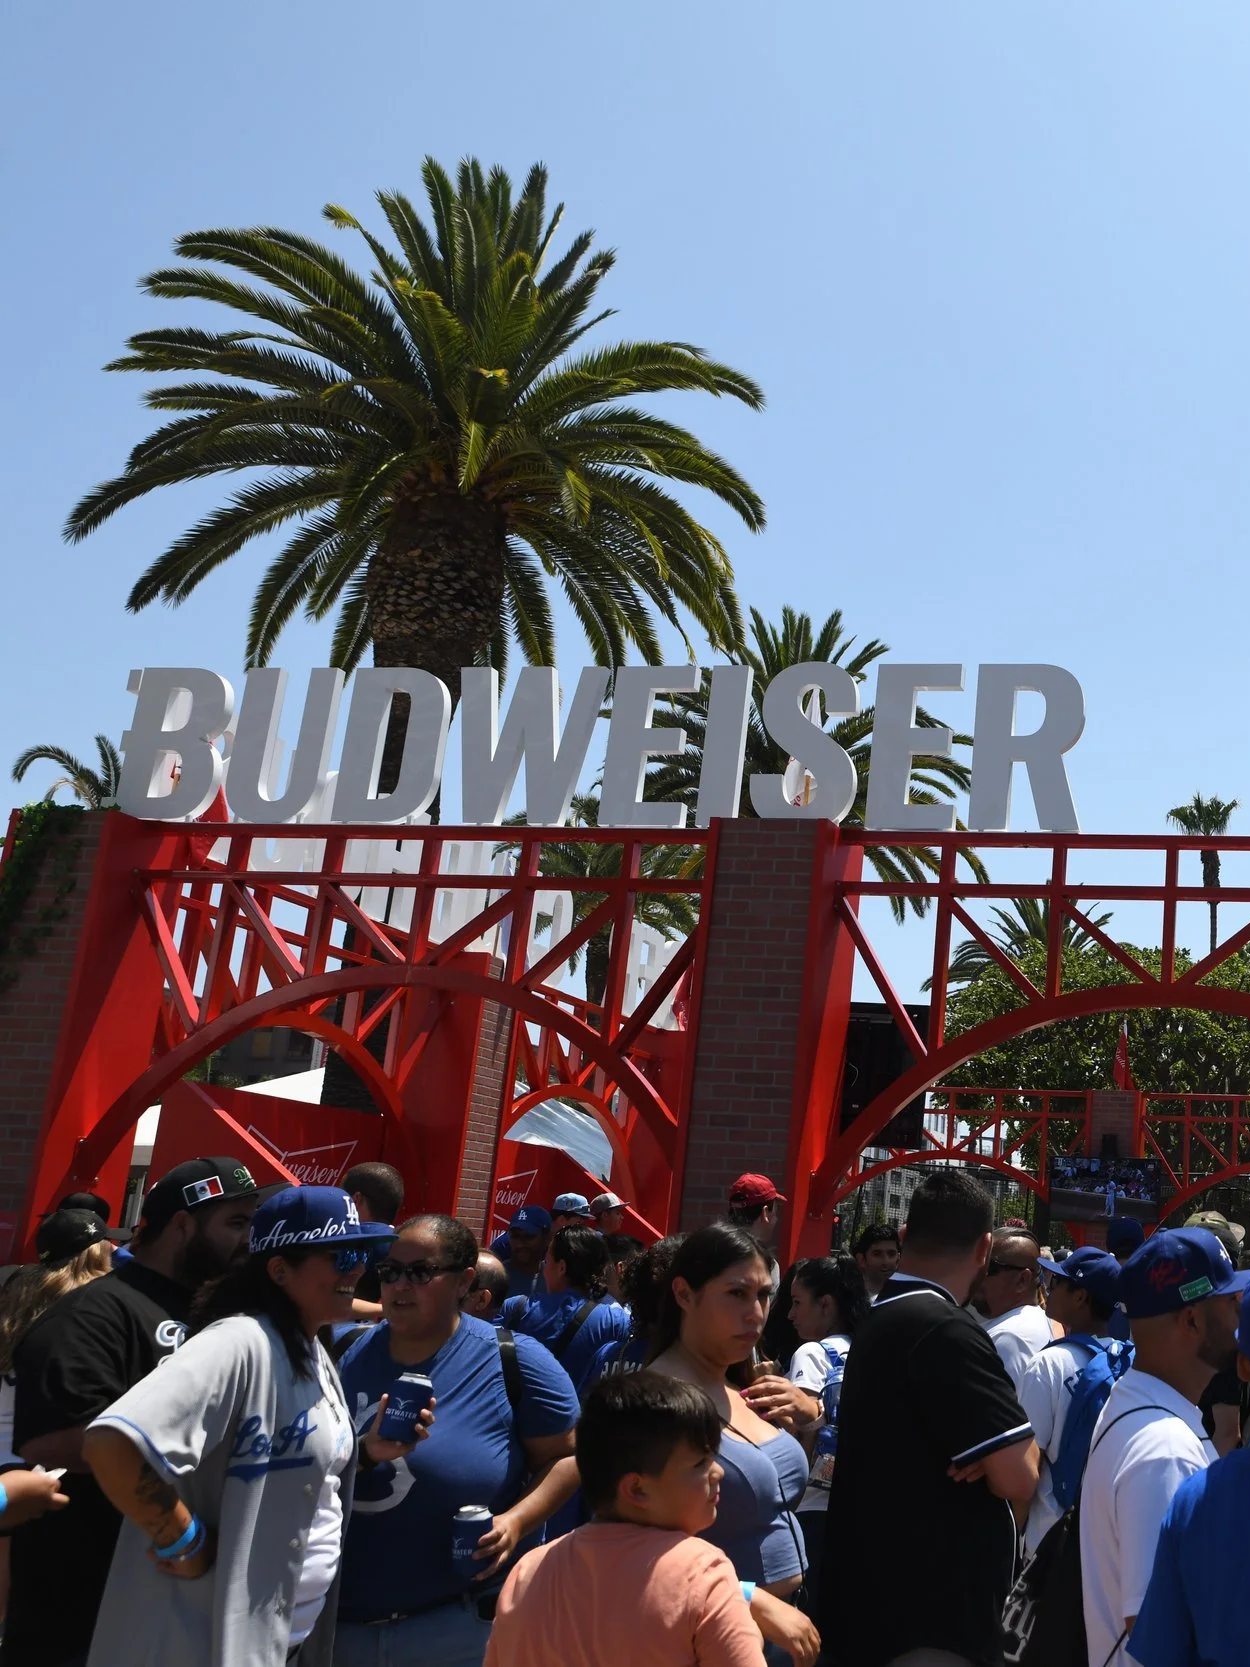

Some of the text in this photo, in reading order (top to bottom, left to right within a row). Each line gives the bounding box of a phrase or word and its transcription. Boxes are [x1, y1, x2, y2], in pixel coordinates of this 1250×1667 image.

[117, 661, 1087, 832] BUDWEISER
[281, 1151, 340, 1184] weiser
[342, 1195, 361, 1226] LA
[495, 1184, 527, 1207] eiser
